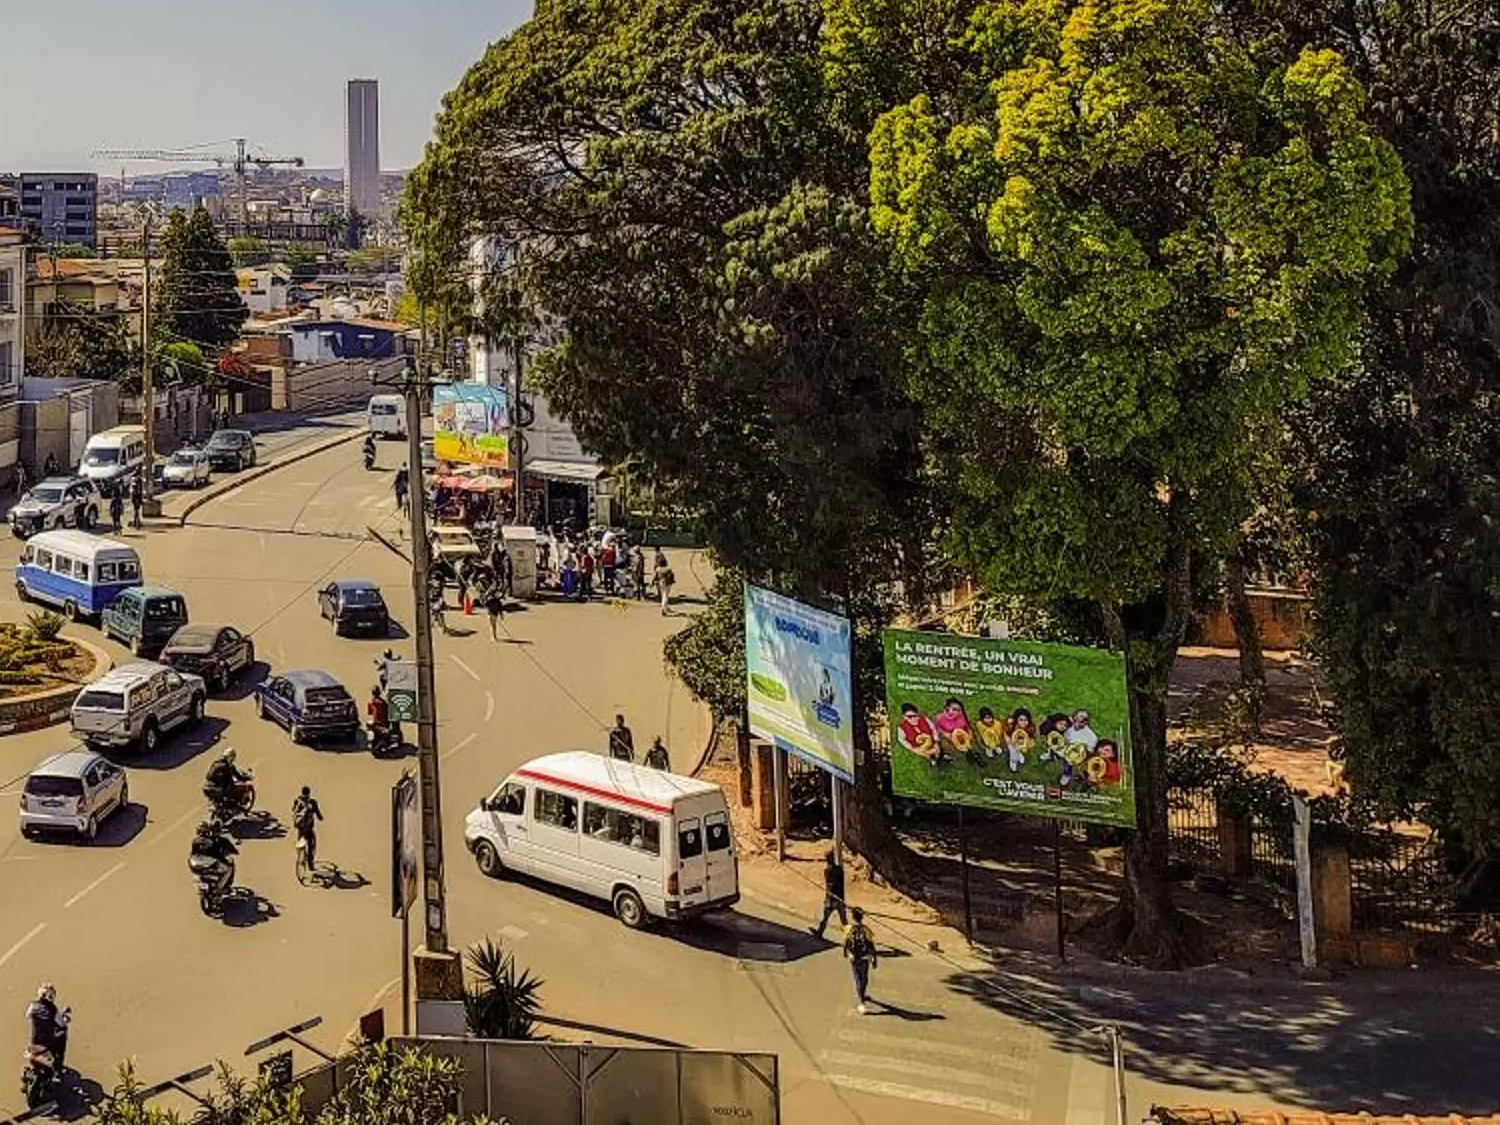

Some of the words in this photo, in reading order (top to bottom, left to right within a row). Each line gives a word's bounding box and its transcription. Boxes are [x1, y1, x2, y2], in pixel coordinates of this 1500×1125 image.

[895, 640, 913, 652] LA
[984, 650, 1006, 663] UN
[1008, 652, 1044, 666] VRAI
[895, 653, 957, 670] MOMENT
[959, 660, 979, 672] DE
[982, 662, 1053, 680] BONHEUR
